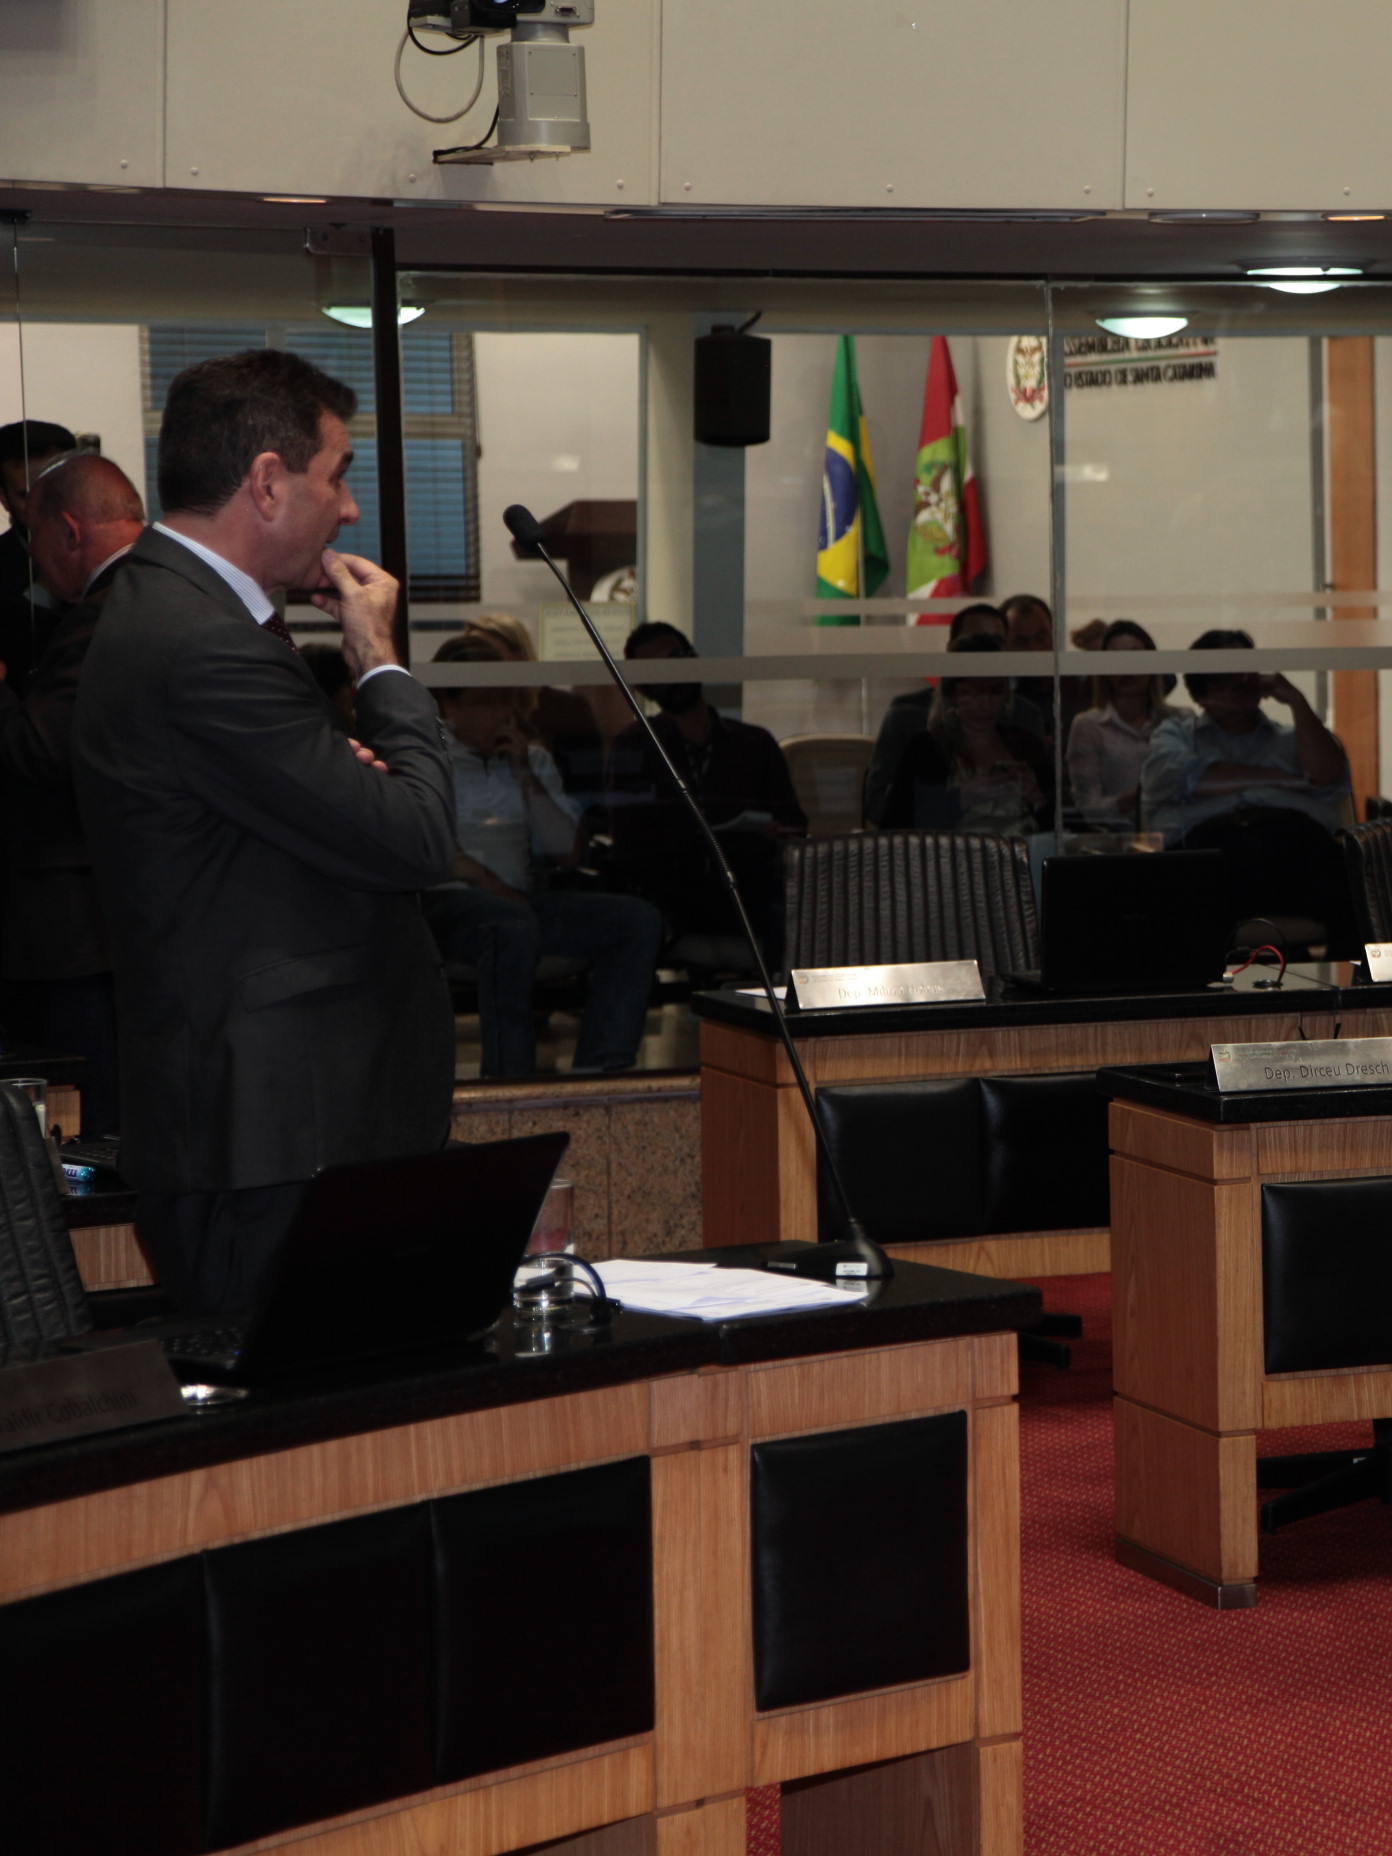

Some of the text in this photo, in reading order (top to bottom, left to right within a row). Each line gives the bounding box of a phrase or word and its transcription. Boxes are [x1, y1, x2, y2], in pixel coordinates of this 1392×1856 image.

[1130, 364, 1163, 384] SANTA
[1264, 1060, 1390, 1082] Dep. Dirceu Dresch
